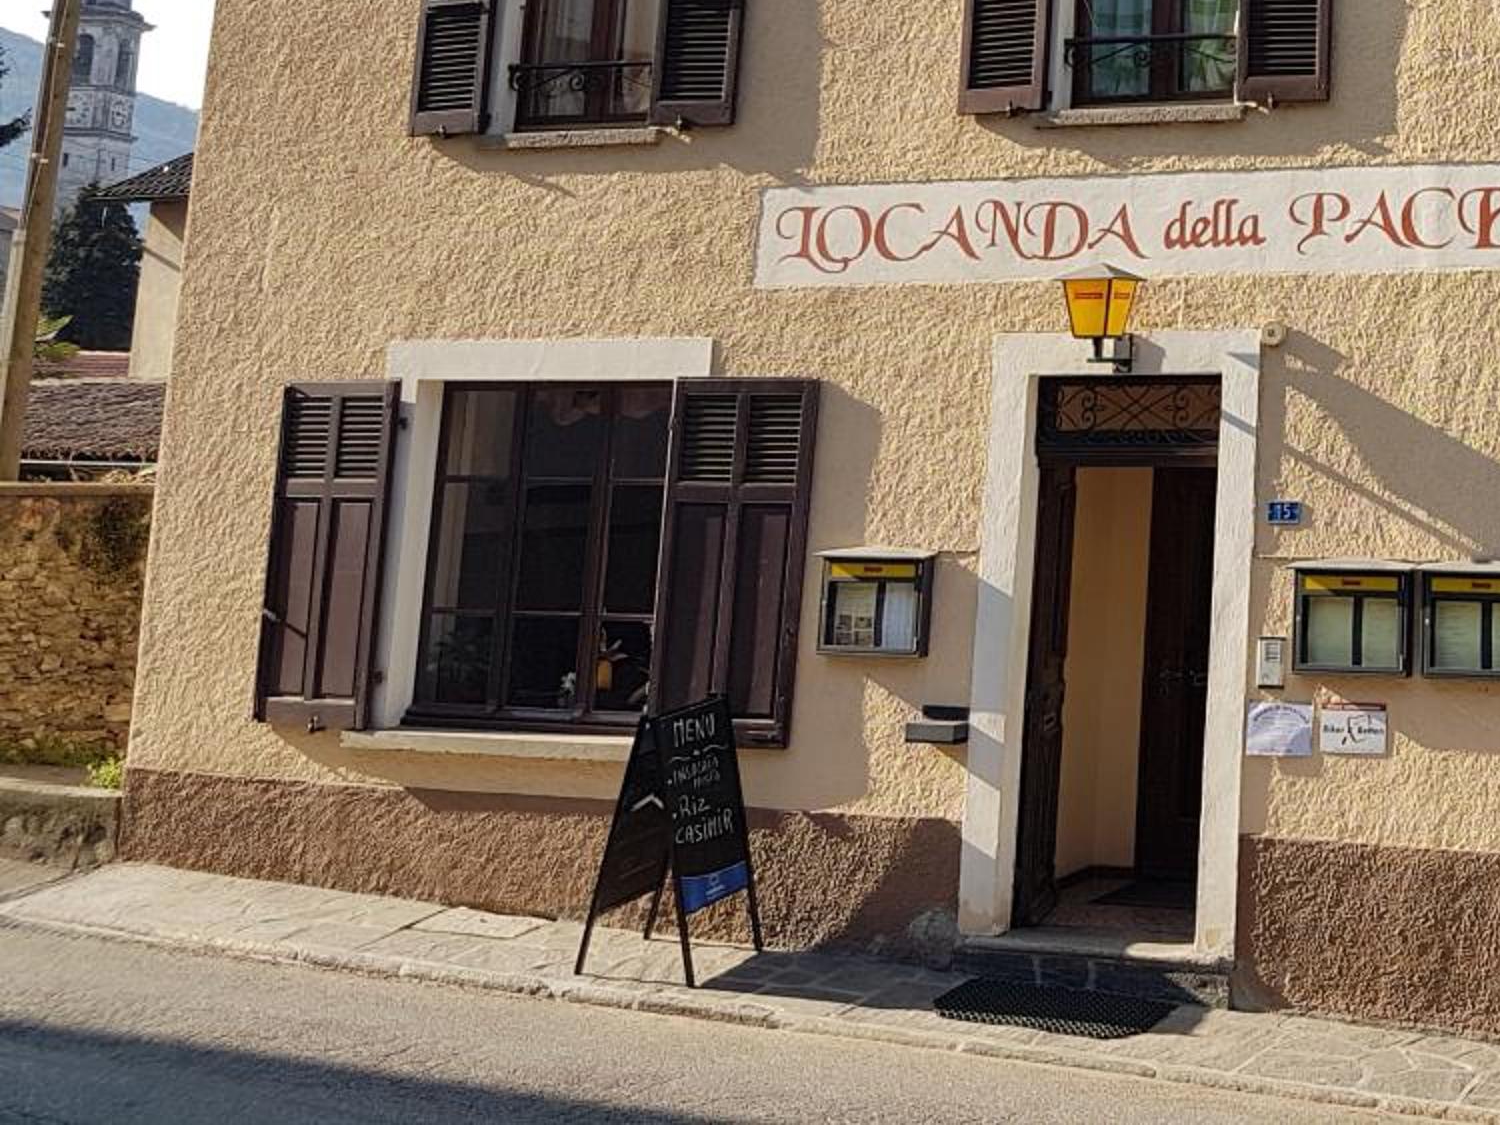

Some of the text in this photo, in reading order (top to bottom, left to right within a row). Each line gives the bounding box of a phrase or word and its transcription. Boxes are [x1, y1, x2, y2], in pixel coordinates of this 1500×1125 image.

[775, 198, 1151, 273] LOCANDA
[1164, 198, 1266, 249] della
[673, 713, 716, 748] MENU
